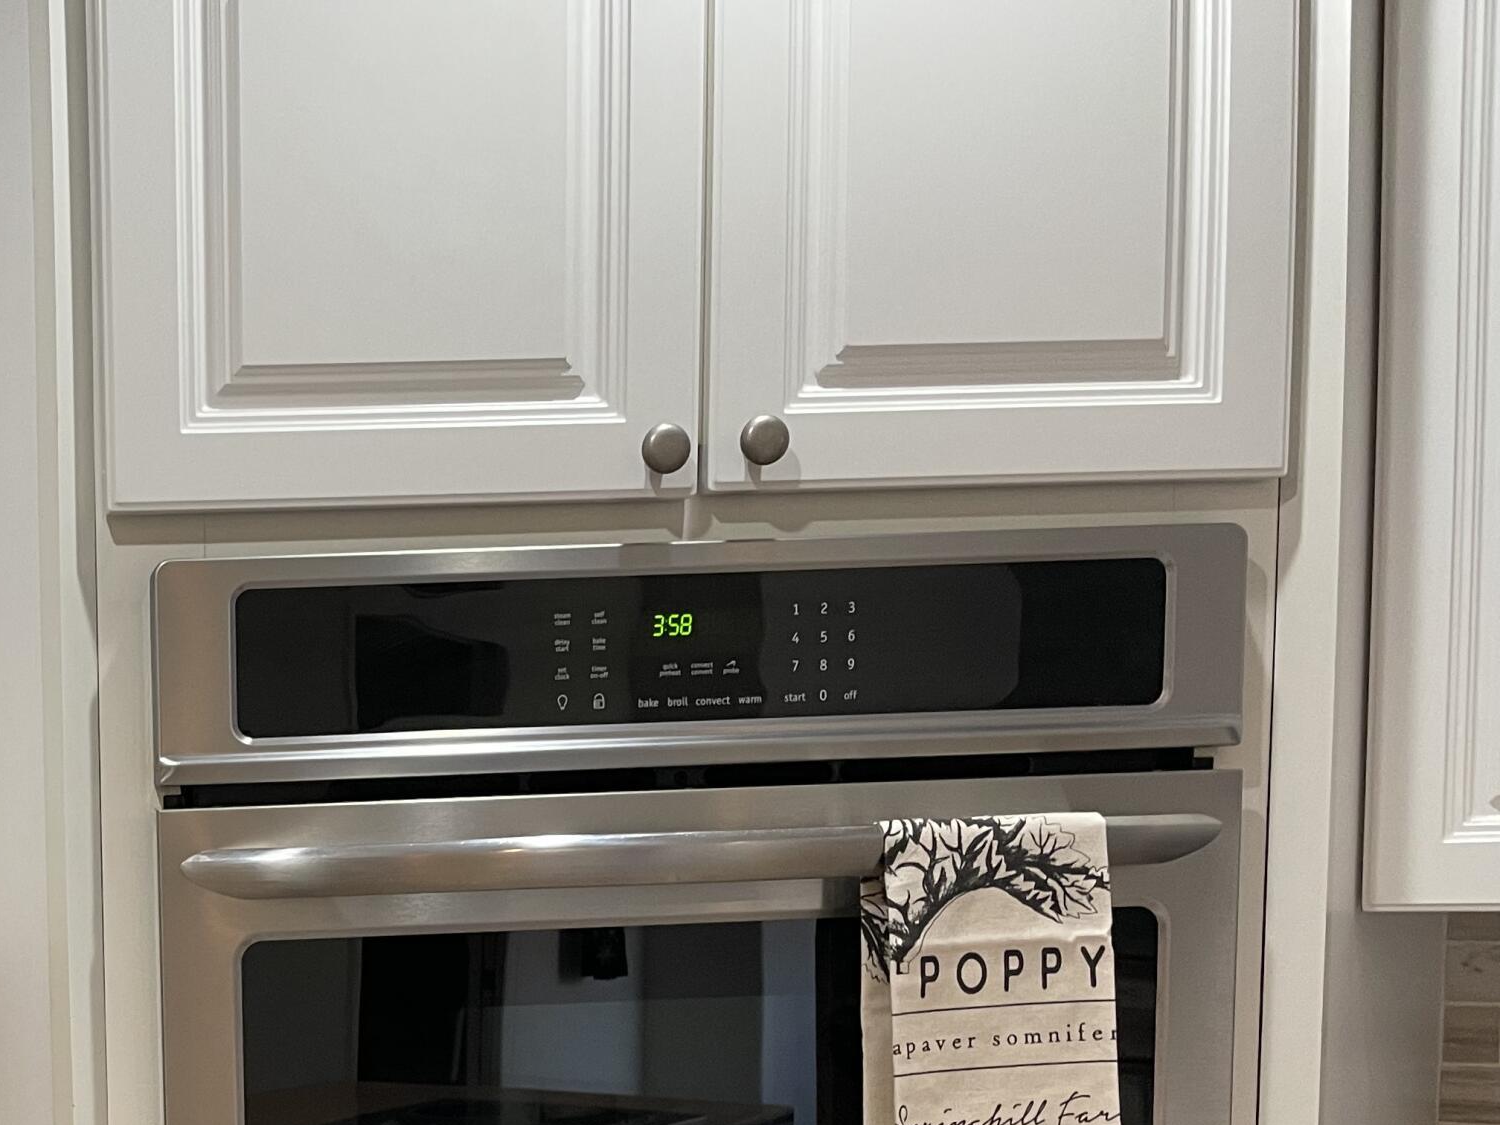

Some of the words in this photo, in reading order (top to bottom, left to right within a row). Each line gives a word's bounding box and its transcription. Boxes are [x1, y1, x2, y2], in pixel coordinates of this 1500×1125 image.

[793, 603, 799, 616] 1
[820, 602, 828, 615] 2
[848, 601, 856, 614] 3
[652, 613, 693, 637] 3:58
[791, 631, 800, 644] 4
[820, 630, 828, 643] 5
[847, 629, 856, 642] 6
[792, 659, 799, 673] 7
[819, 658, 828, 671] 8
[847, 657, 855, 670] 9
[638, 698, 660, 708] bake
[667, 696, 689, 708] broil
[695, 696, 731, 706] convect
[738, 696, 762, 705] warm
[783, 692, 806, 703] start
[819, 689, 828, 702] 0
[843, 689, 858, 701] off
[920, 944, 1106, 998] POPPY
